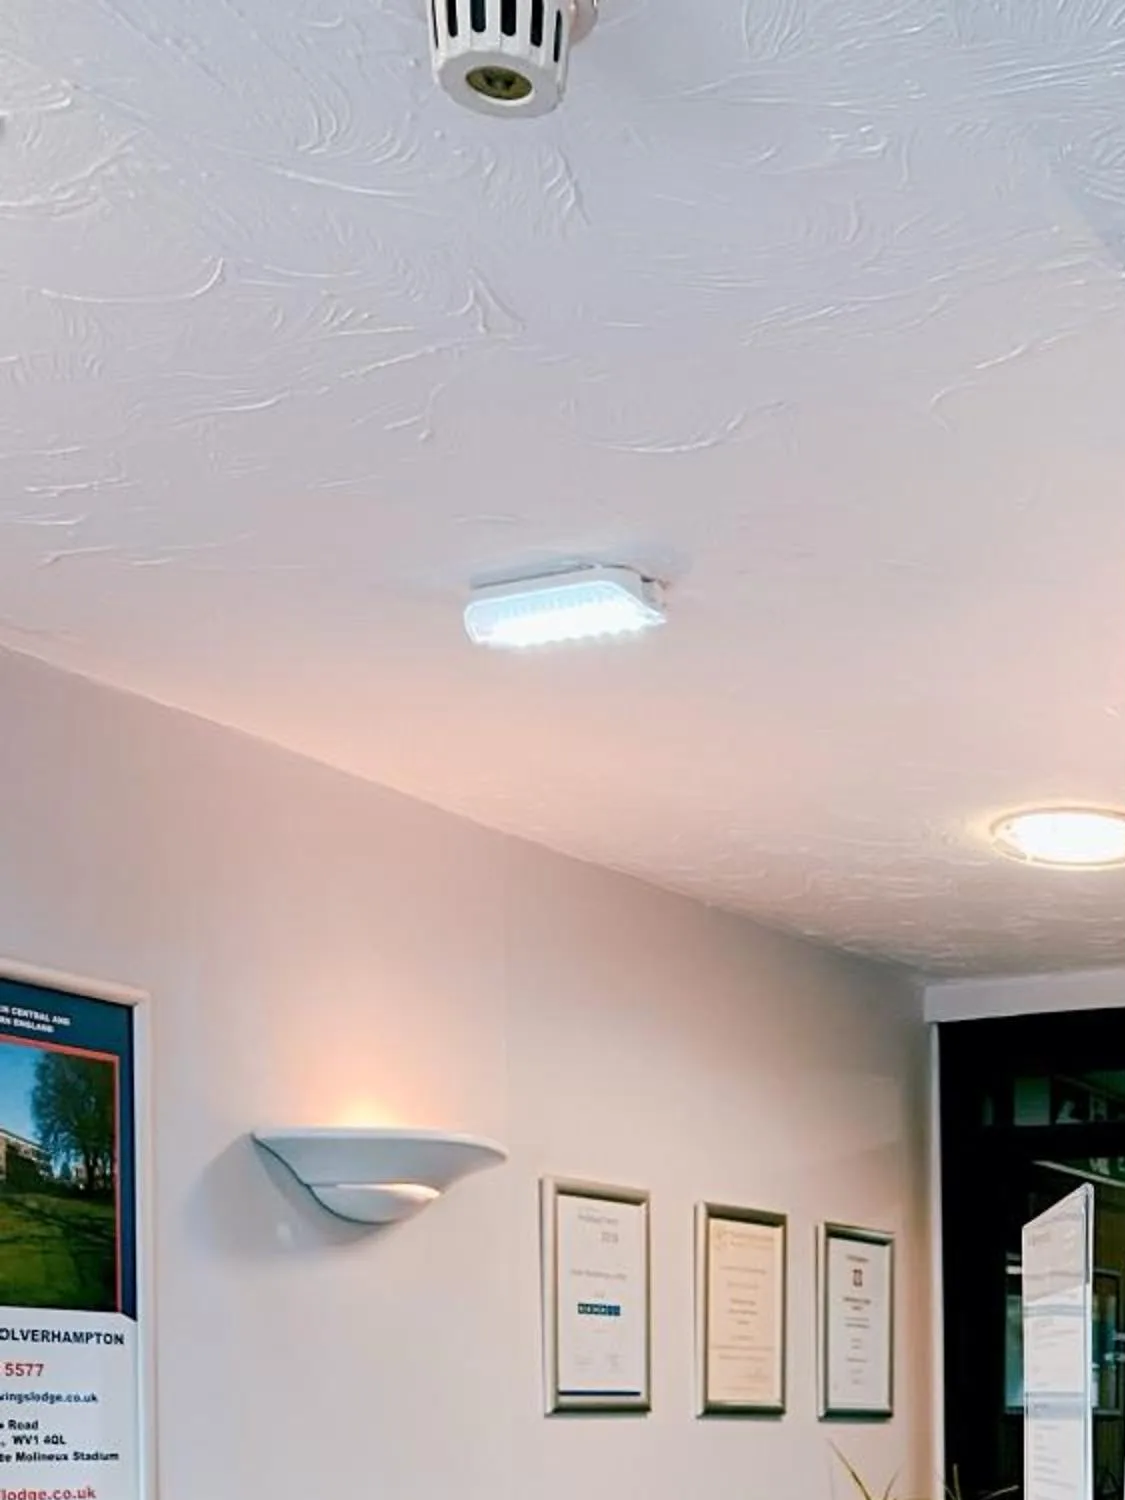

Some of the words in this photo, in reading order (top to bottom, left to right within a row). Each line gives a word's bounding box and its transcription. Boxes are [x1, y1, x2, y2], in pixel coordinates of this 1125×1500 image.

[0, 1327, 125, 1345] OLVERHAMPTON
[4, 1362, 45, 1377] 5577
[8, 1419, 39, 1430] Road
[12, 1434, 39, 1445] WV1
[15, 1451, 69, 1462] Molineux
[72, 1450, 119, 1461] Stadium
